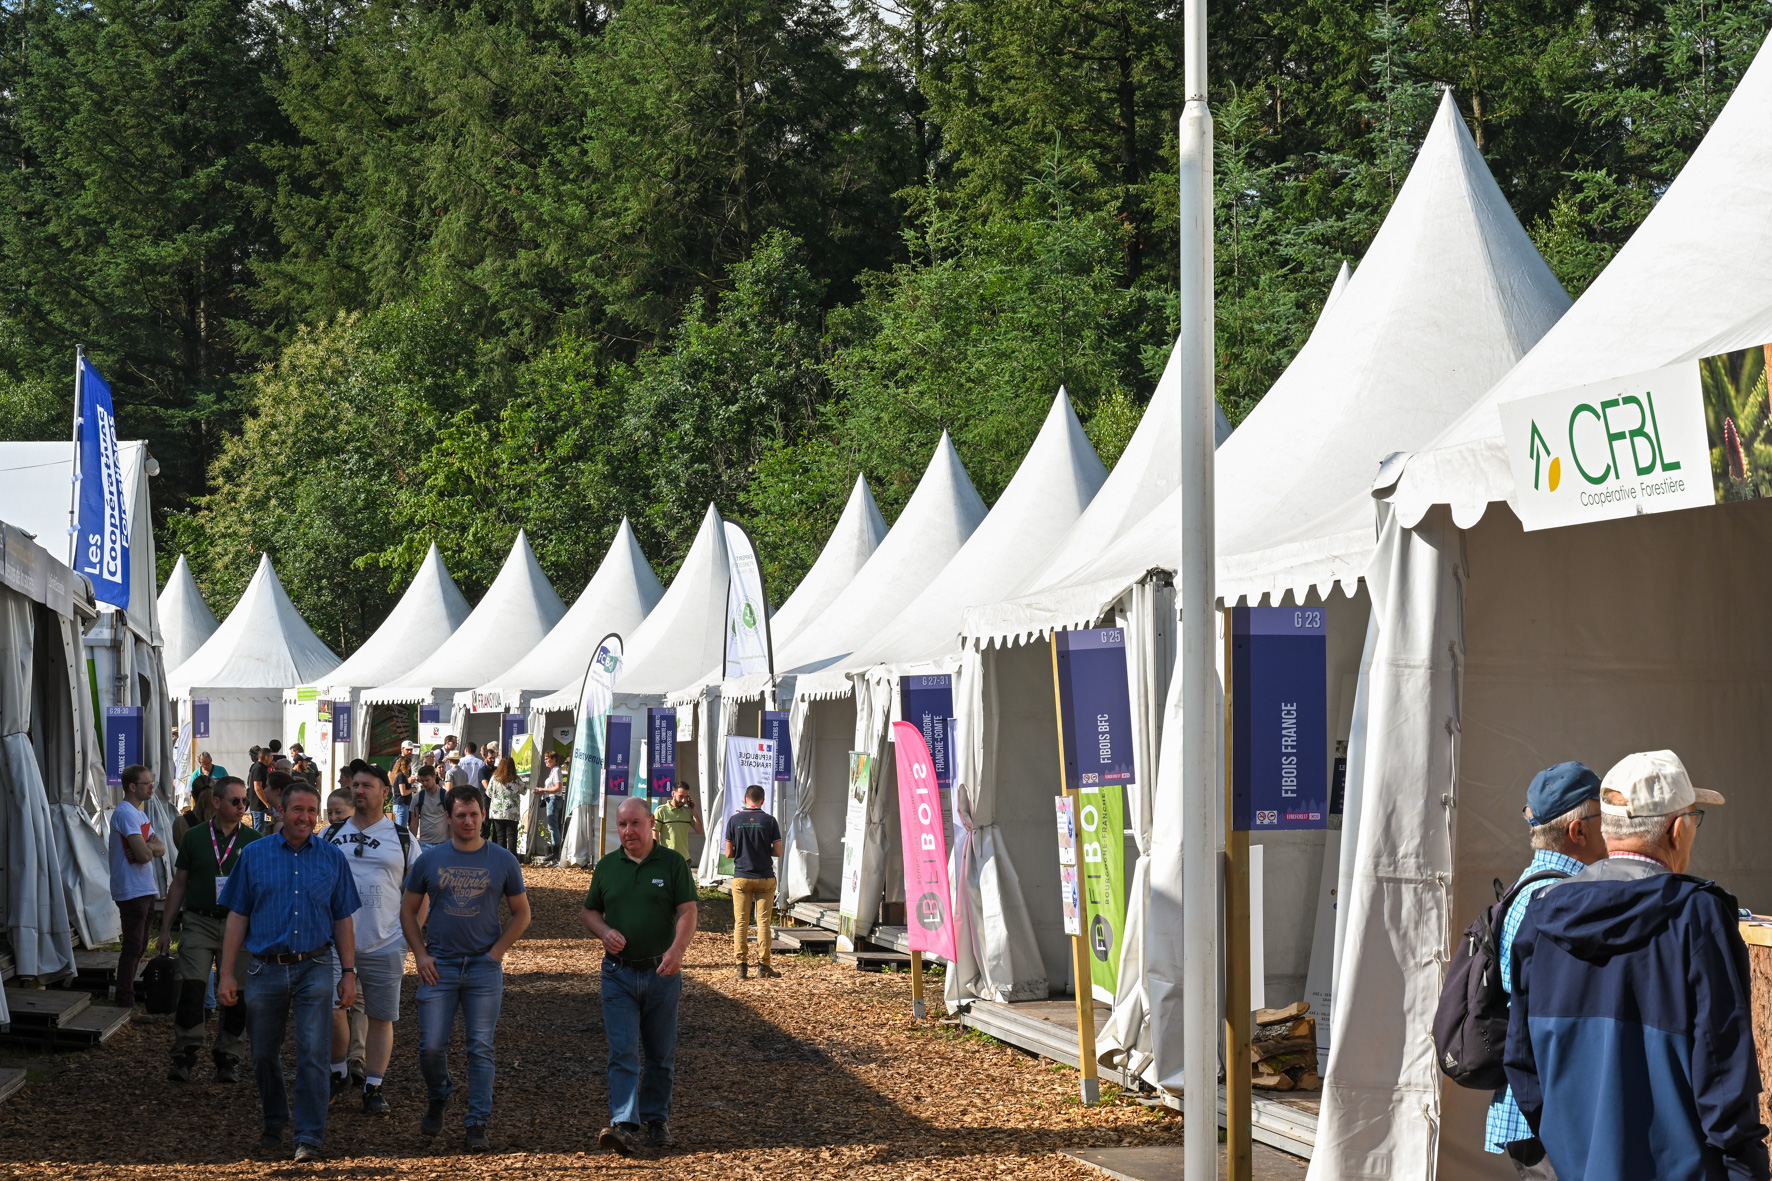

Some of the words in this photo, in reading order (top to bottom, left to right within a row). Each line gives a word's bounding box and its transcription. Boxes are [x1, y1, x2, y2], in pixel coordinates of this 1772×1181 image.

[1569, 391, 1681, 485] CFBL
[1580, 486, 1637, 507] Coopérative
[1640, 476, 1685, 498] Forestière
[84, 533, 101, 575] Les
[1294, 612, 1302, 628] G
[1305, 611, 1321, 628] 23
[1101, 631, 1107, 643] G
[1109, 631, 1121, 642] 25
[922, 677, 927, 686] G
[928, 676, 949, 685] 27-31
[1097, 713, 1109, 732] BFC
[1282, 702, 1297, 753] FRANCE
[574, 748, 604, 766] Bienvenue
[934, 715, 944, 772] FRANCHE-COMTE
[1099, 733, 1111, 764] FIBOIS
[1282, 756, 1297, 798] FIBOIS
[370, 885, 383, 894] CO.
